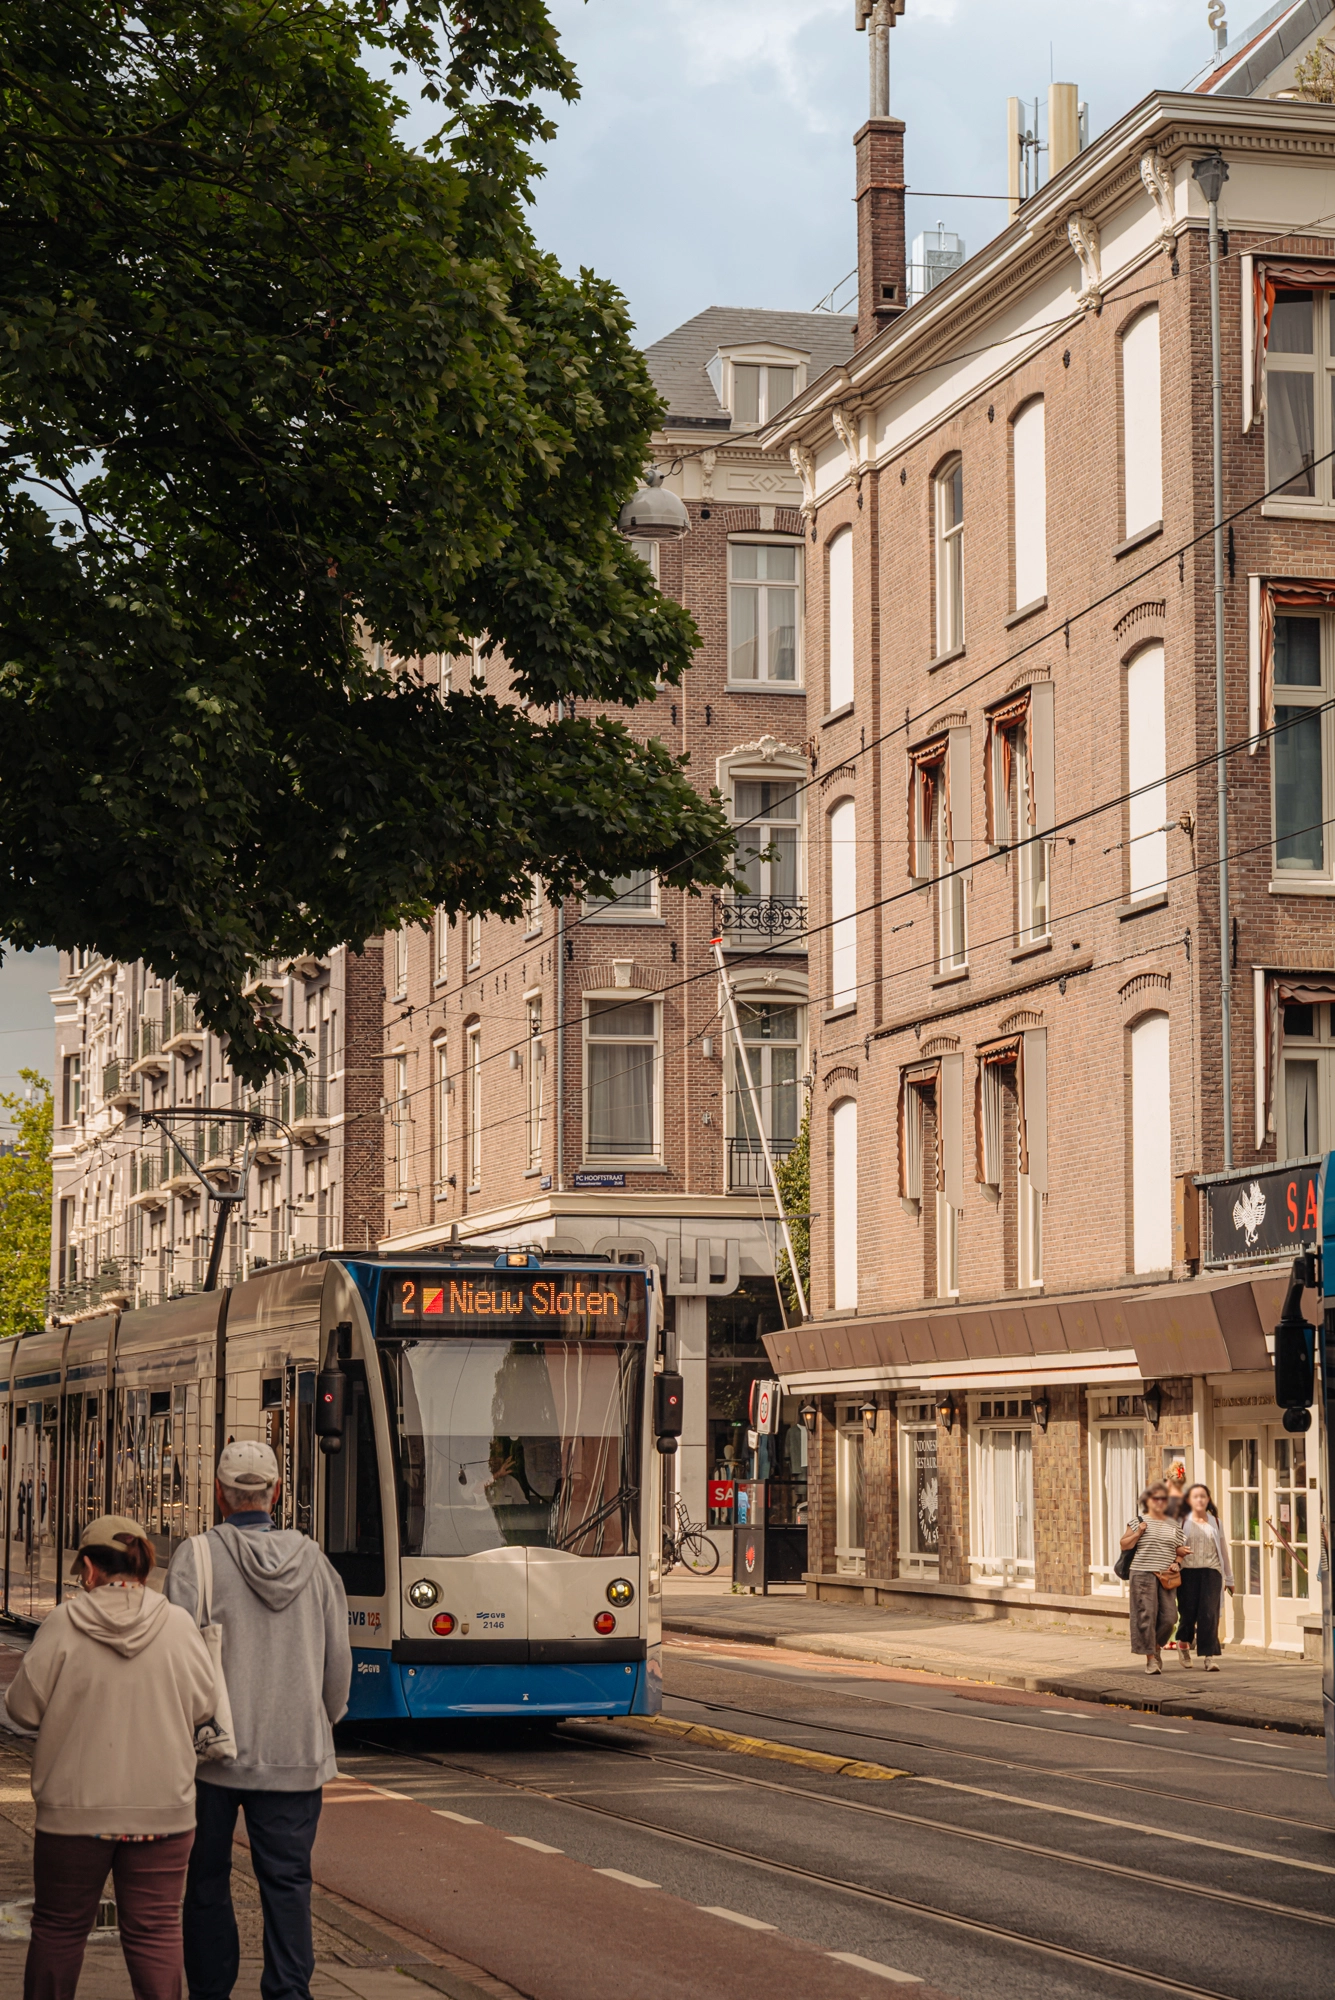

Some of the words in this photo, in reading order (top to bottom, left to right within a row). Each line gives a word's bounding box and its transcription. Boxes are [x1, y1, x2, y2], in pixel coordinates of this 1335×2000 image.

[401, 1281, 415, 1314] 2
[449, 1281, 524, 1314] Nieuw
[532, 1282, 619, 1315] Sloten
[367, 1612, 381, 1627] 125
[482, 1621, 505, 1629] 2146
[368, 1664, 381, 1673] GVB
